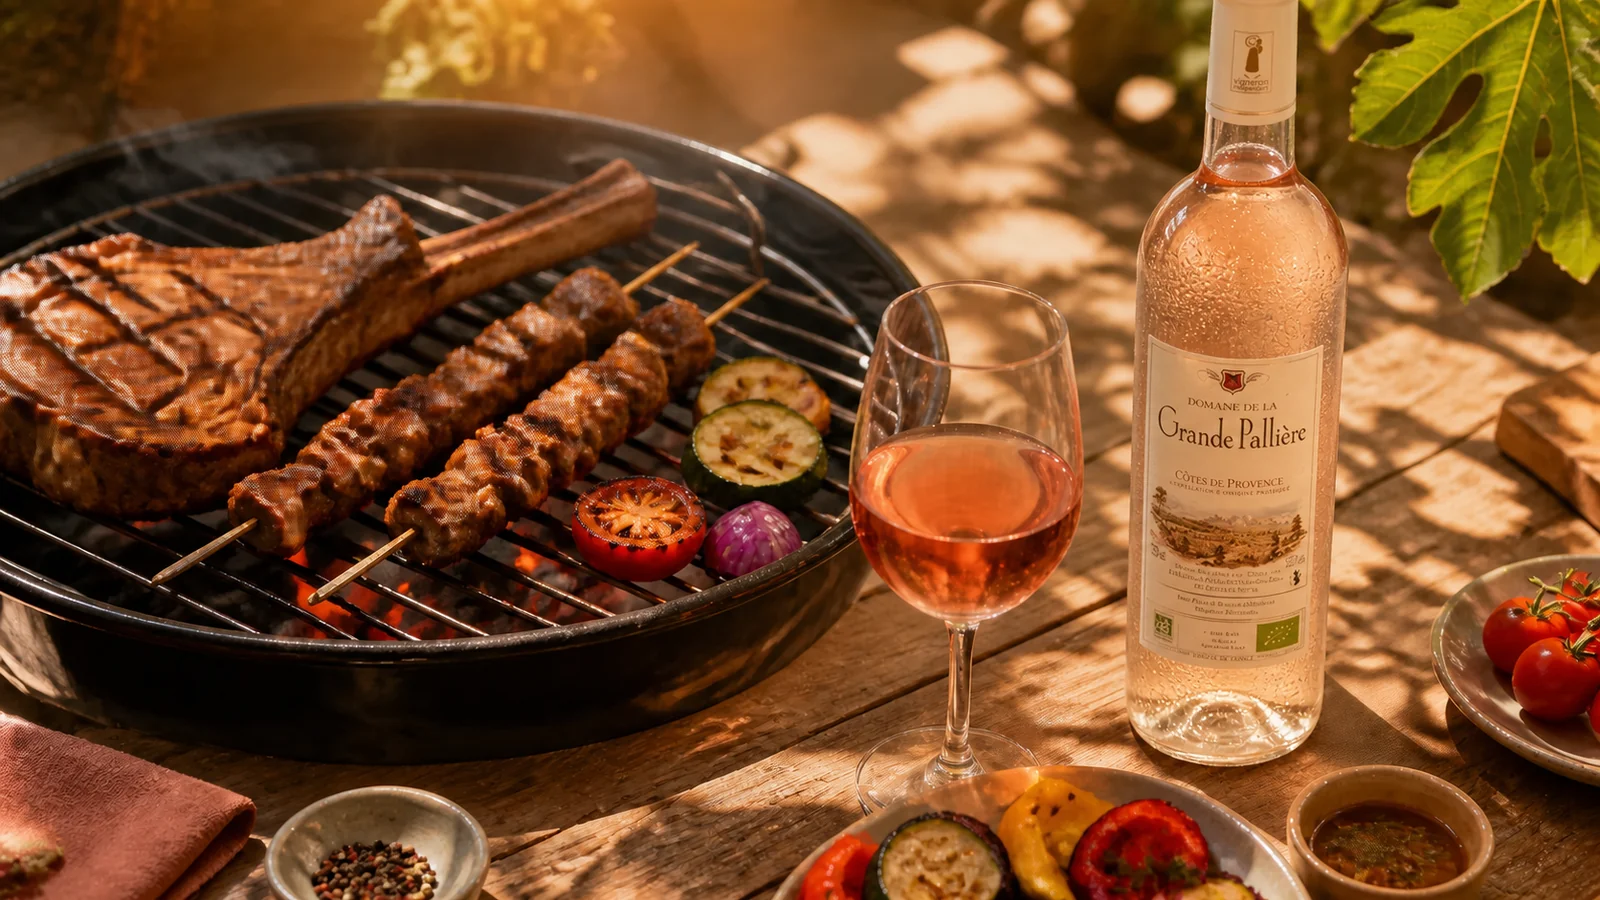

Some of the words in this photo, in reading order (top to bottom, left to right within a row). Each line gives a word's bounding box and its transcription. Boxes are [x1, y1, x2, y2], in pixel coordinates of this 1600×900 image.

[1243, 403, 1260, 412] DE
[1263, 402, 1278, 411] LA
[1158, 405, 1234, 449] Grande
[1238, 416, 1306, 449] Pallière
[1210, 478, 1225, 488] DE
[1227, 477, 1284, 489] PROVENCE
